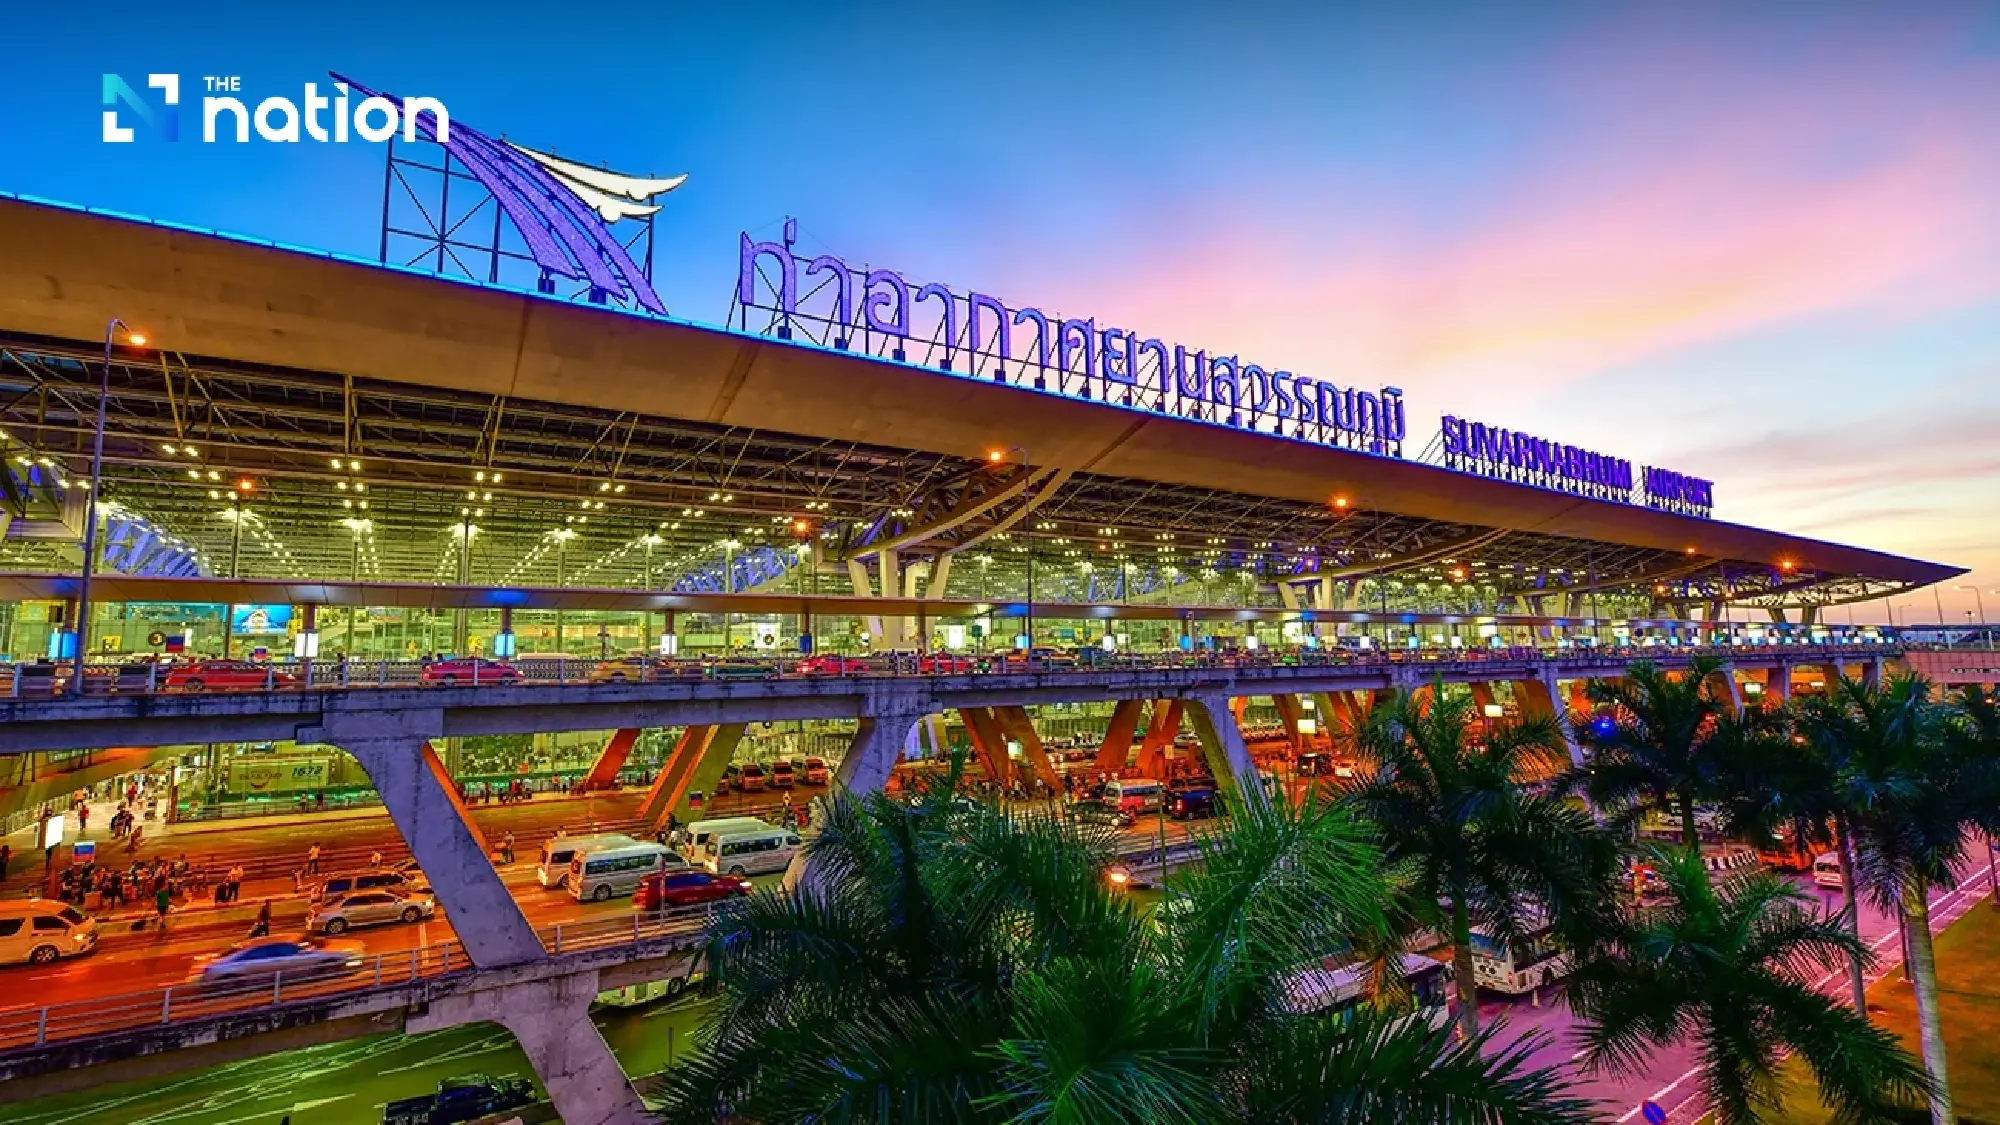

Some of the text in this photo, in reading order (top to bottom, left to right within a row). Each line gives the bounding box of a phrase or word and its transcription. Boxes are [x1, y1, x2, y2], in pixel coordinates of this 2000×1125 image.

[740, 218, 1406, 456] ท่าอากาศยานสุวรรณภูมิ
[1441, 415, 1714, 507] SUVARNABHUMI AIRPORT
